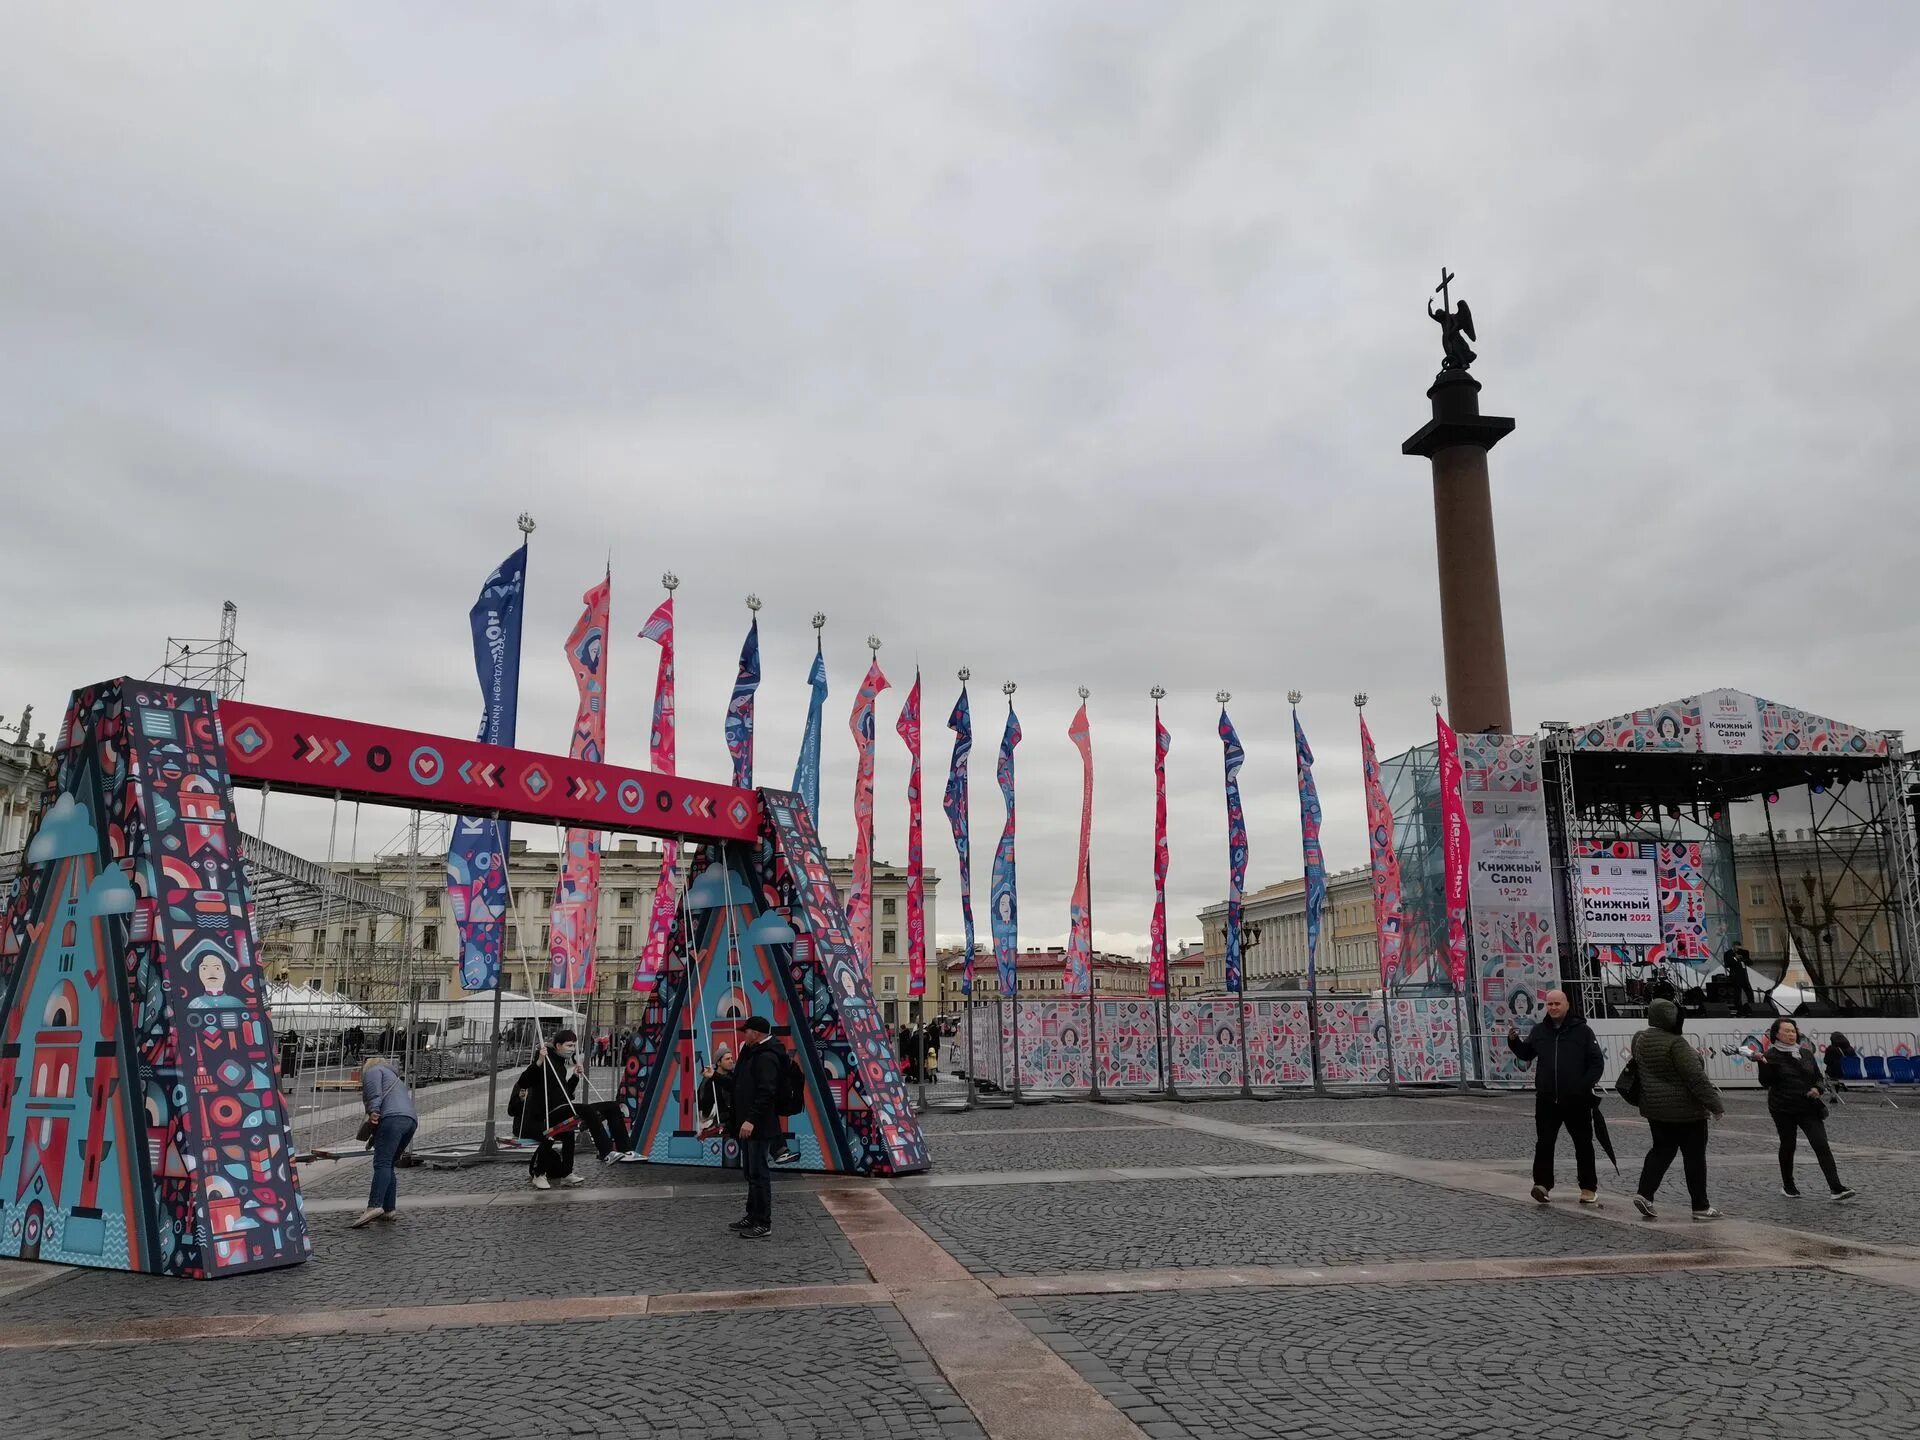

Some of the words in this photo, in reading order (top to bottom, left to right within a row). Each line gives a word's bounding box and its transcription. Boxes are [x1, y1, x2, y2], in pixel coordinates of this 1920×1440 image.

[1709, 721, 1753, 729] Книжный
[1718, 729, 1746, 737] Салон
[1477, 861, 1542, 872] Книжный
[1491, 873, 1532, 884] Салон
[1584, 897, 1650, 909] Книжный
[1585, 911, 1627, 921] Салон
